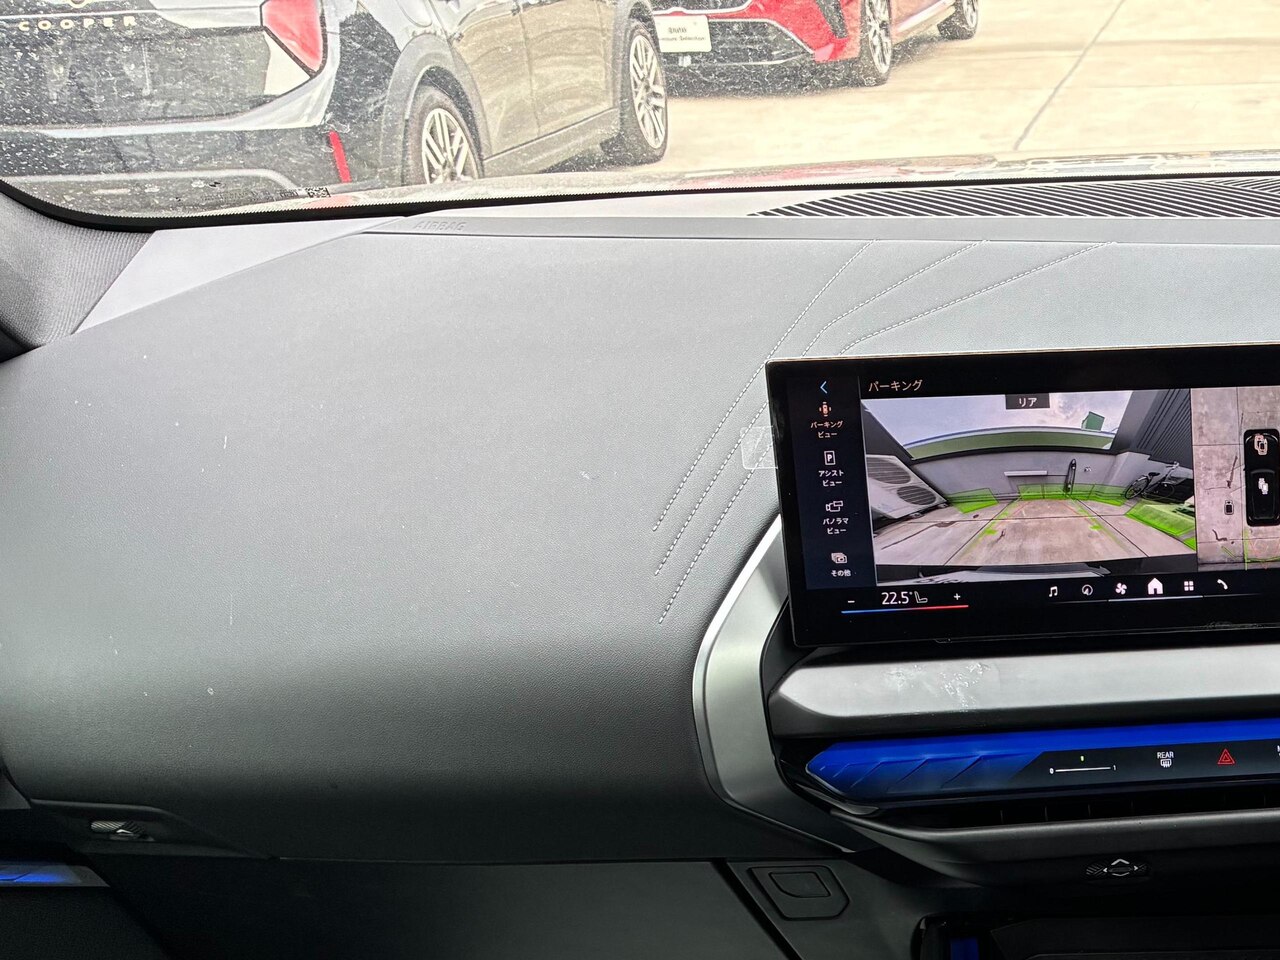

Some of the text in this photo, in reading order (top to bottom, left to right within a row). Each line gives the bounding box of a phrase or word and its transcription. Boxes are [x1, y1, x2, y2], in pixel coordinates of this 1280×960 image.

[17, 15, 136, 32] COOPER
[413, 220, 467, 231] AIRBAG
[868, 379, 923, 392] パーキング
[1018, 396, 1038, 407] リア
[810, 420, 844, 429] パーキング
[817, 430, 838, 439] ビュー
[818, 470, 845, 478] アシスト
[822, 479, 843, 488] ビュー
[822, 517, 849, 526] パノラマ
[826, 527, 847, 536] ビュー
[830, 569, 851, 577] その他
[1157, 751, 1174, 760] REAR
